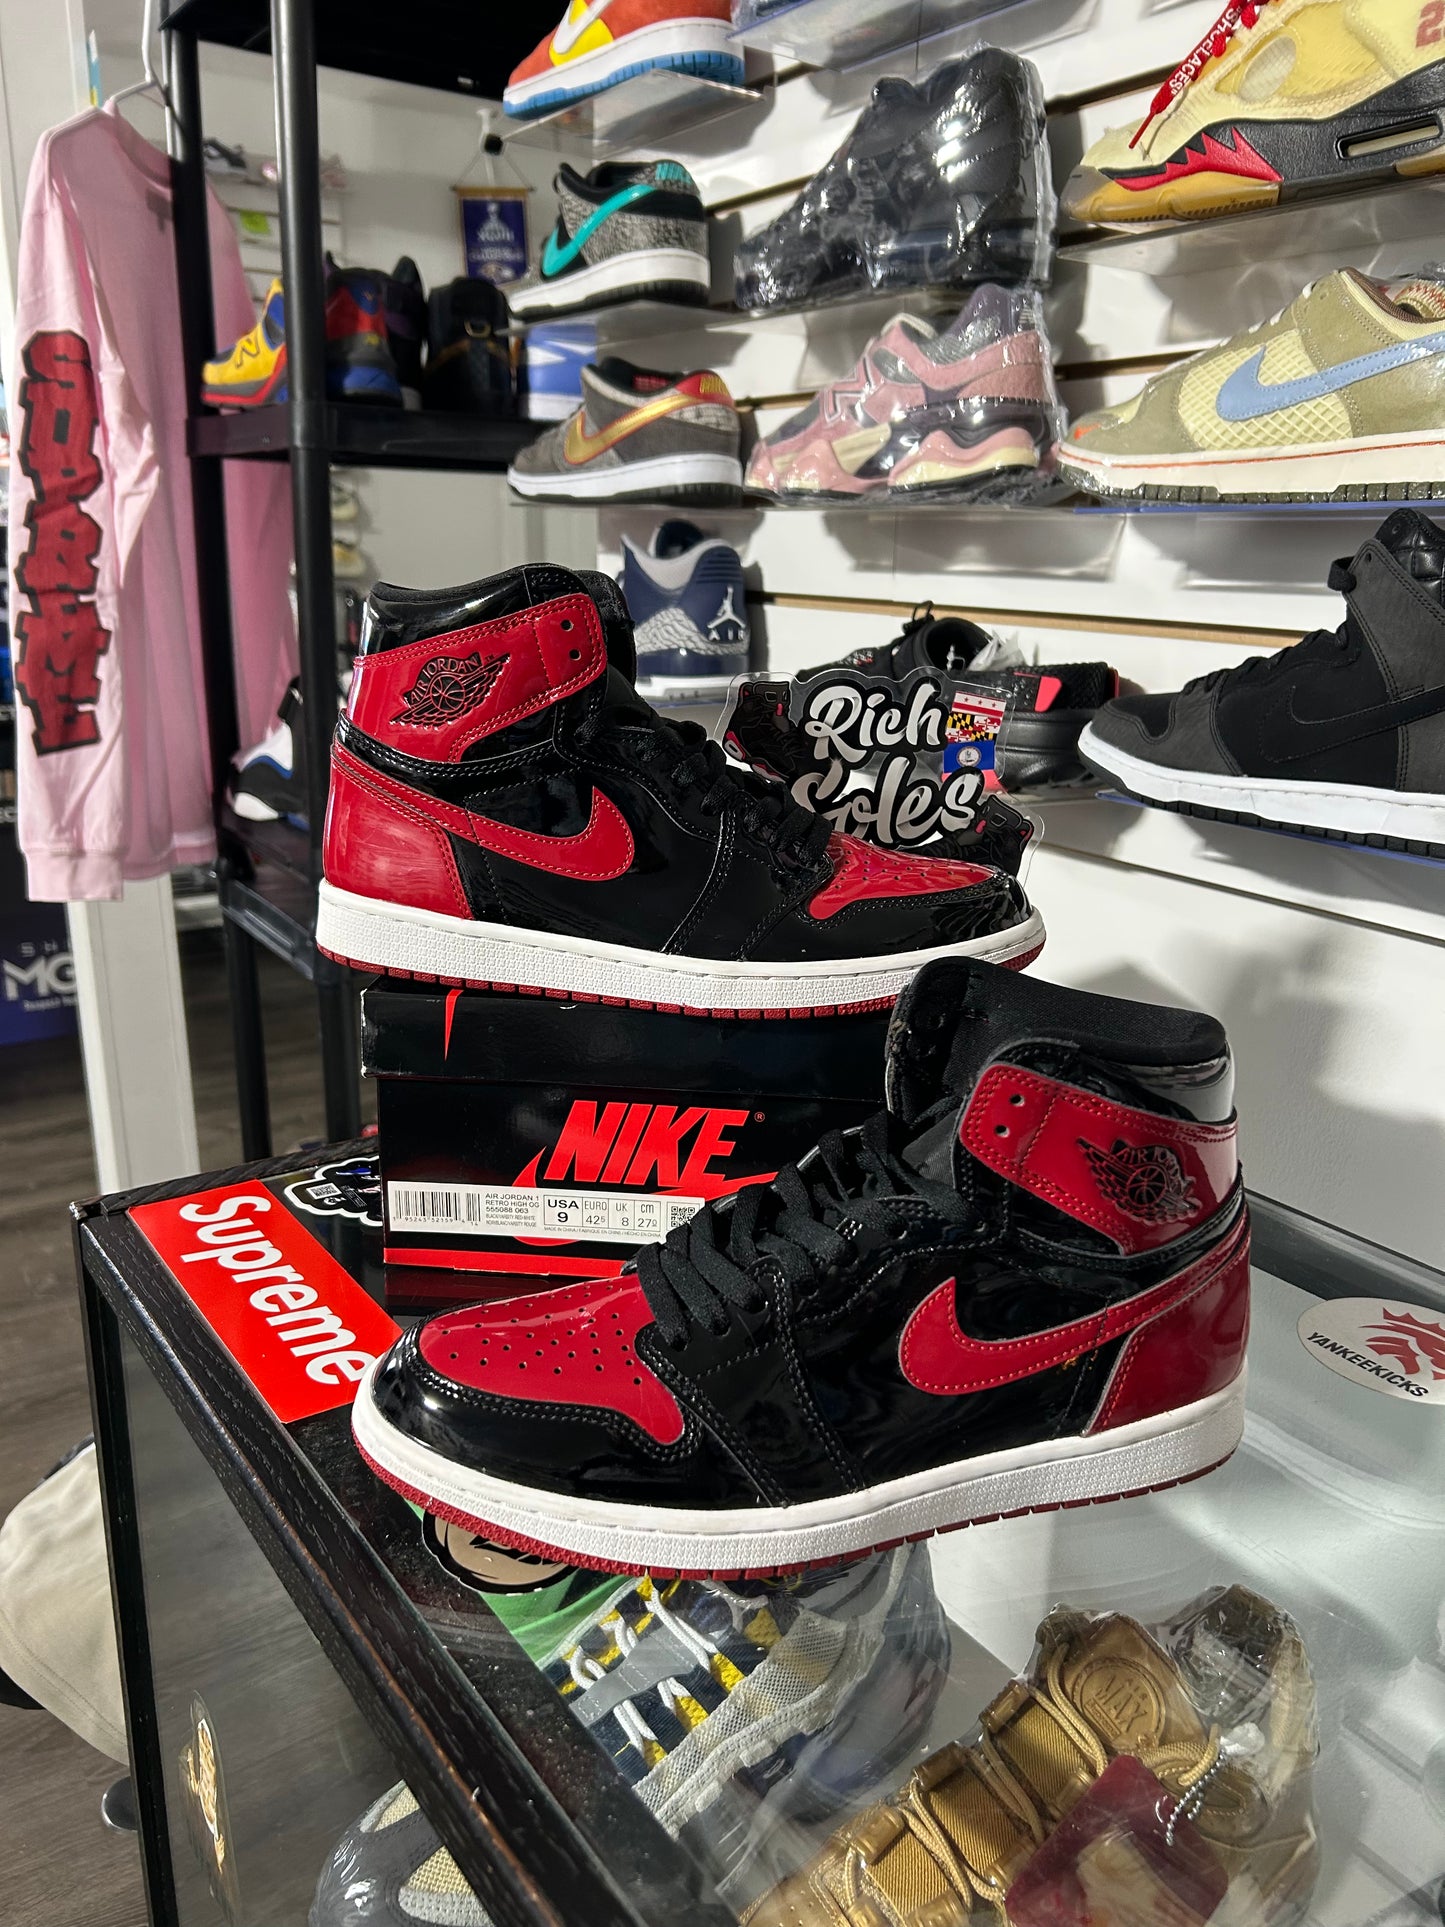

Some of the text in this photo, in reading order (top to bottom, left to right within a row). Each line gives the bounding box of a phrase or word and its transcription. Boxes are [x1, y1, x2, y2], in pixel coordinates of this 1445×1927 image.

[1415, 1, 1445, 48] 2
[410, 680, 430, 704] AIR
[804, 682, 943, 763] Rich
[791, 755, 980, 844] Soles
[543, 1100, 750, 1187] NIKE
[547, 1199, 579, 1210] USA
[557, 1211, 569, 1223] 9
[584, 1200, 607, 1211] EURO
[615, 1202, 628, 1212] UK
[621, 1217, 630, 1227] 8
[179, 1195, 377, 1385] Supreme
[1307, 1331, 1429, 1397] YANKEEKICKS
